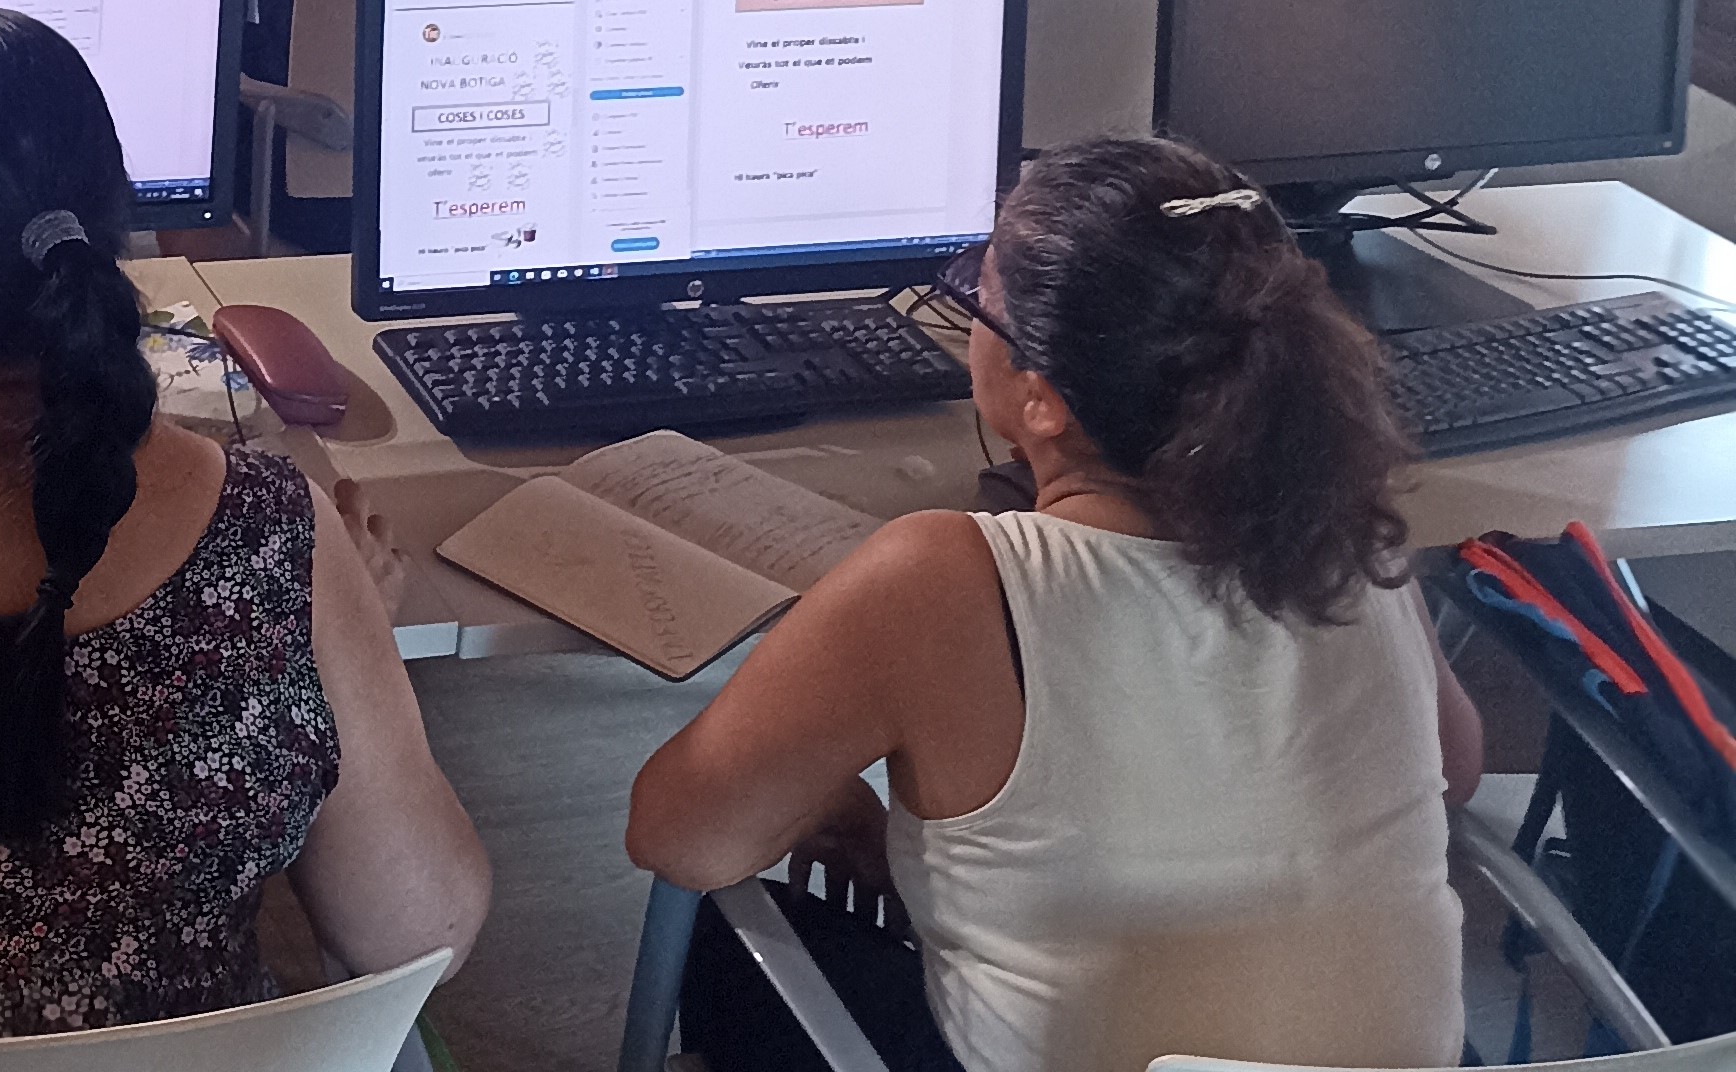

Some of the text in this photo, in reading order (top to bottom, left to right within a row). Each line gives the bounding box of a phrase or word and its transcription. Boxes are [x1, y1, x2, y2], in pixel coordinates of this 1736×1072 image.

[420, 79, 455, 91] NOVA
[438, 111, 477, 124] COSES
[487, 108, 526, 121] COSES
